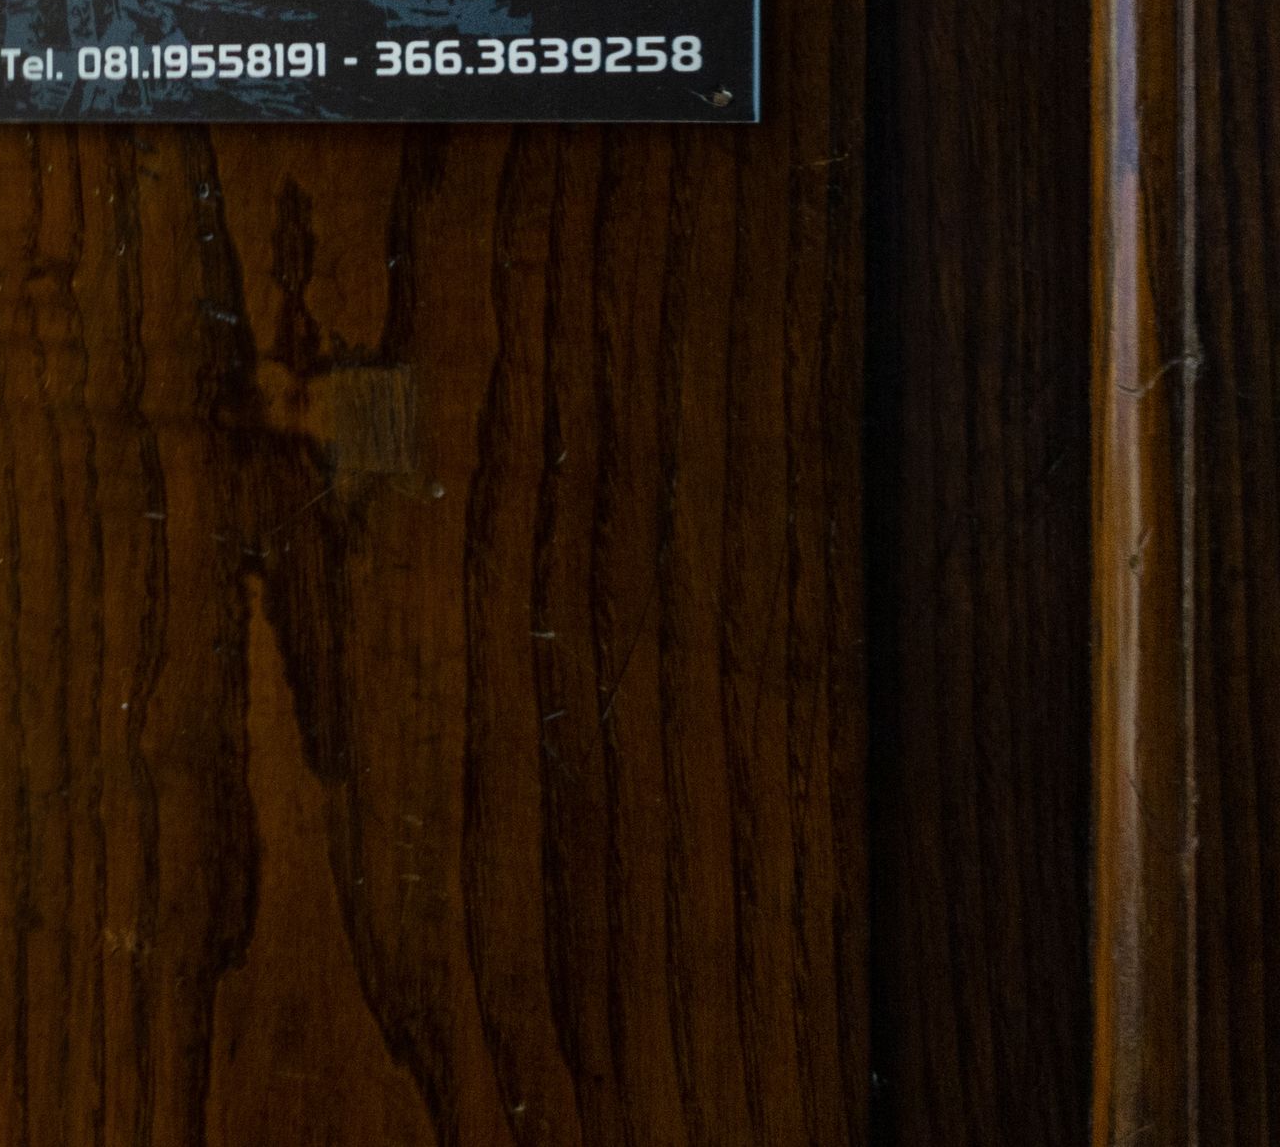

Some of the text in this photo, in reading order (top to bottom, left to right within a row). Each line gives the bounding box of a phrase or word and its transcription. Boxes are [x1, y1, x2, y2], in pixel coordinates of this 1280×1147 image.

[1, 48, 64, 81] Tel.
[77, 42, 328, 79] 081.19558191
[375, 36, 703, 76] 366.3639258
